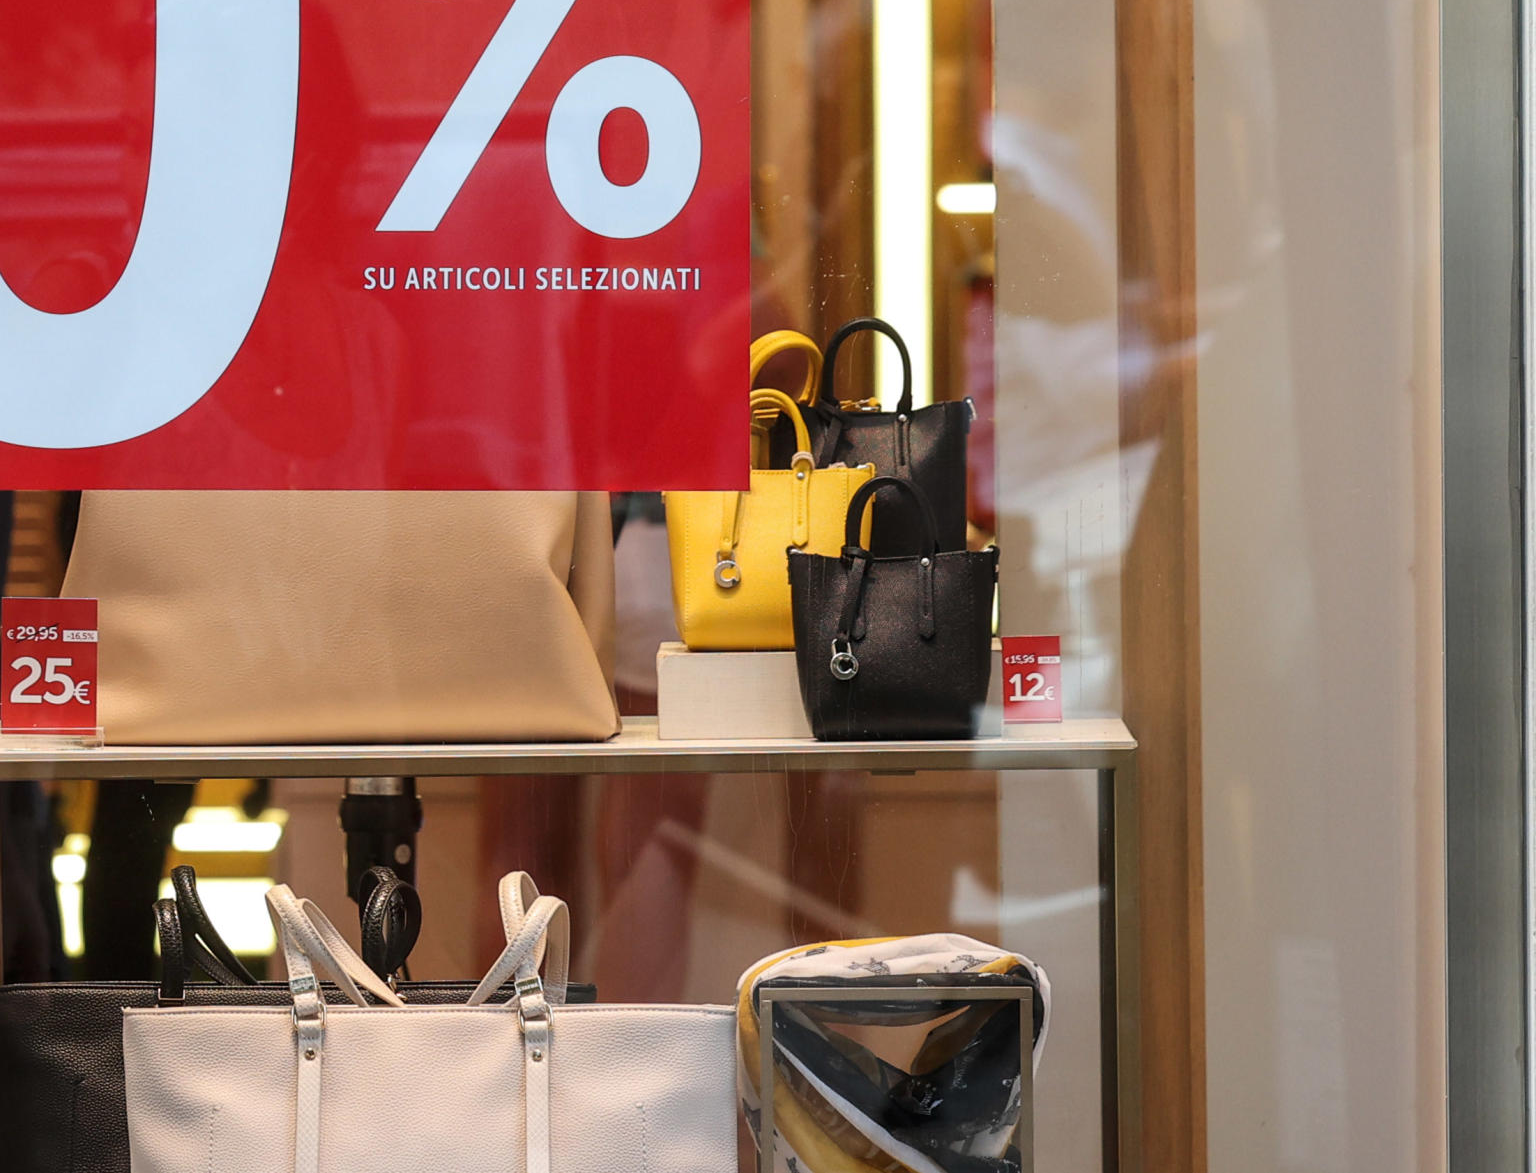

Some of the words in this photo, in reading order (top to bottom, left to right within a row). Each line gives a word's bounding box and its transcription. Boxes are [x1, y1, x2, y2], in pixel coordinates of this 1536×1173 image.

[363, 266, 395, 291] SU
[404, 266, 525, 291] ARTICOLI
[535, 266, 701, 291] SELEZIONATI
[10, 656, 91, 705] 25€
[1008, 672, 1055, 702] 12€
